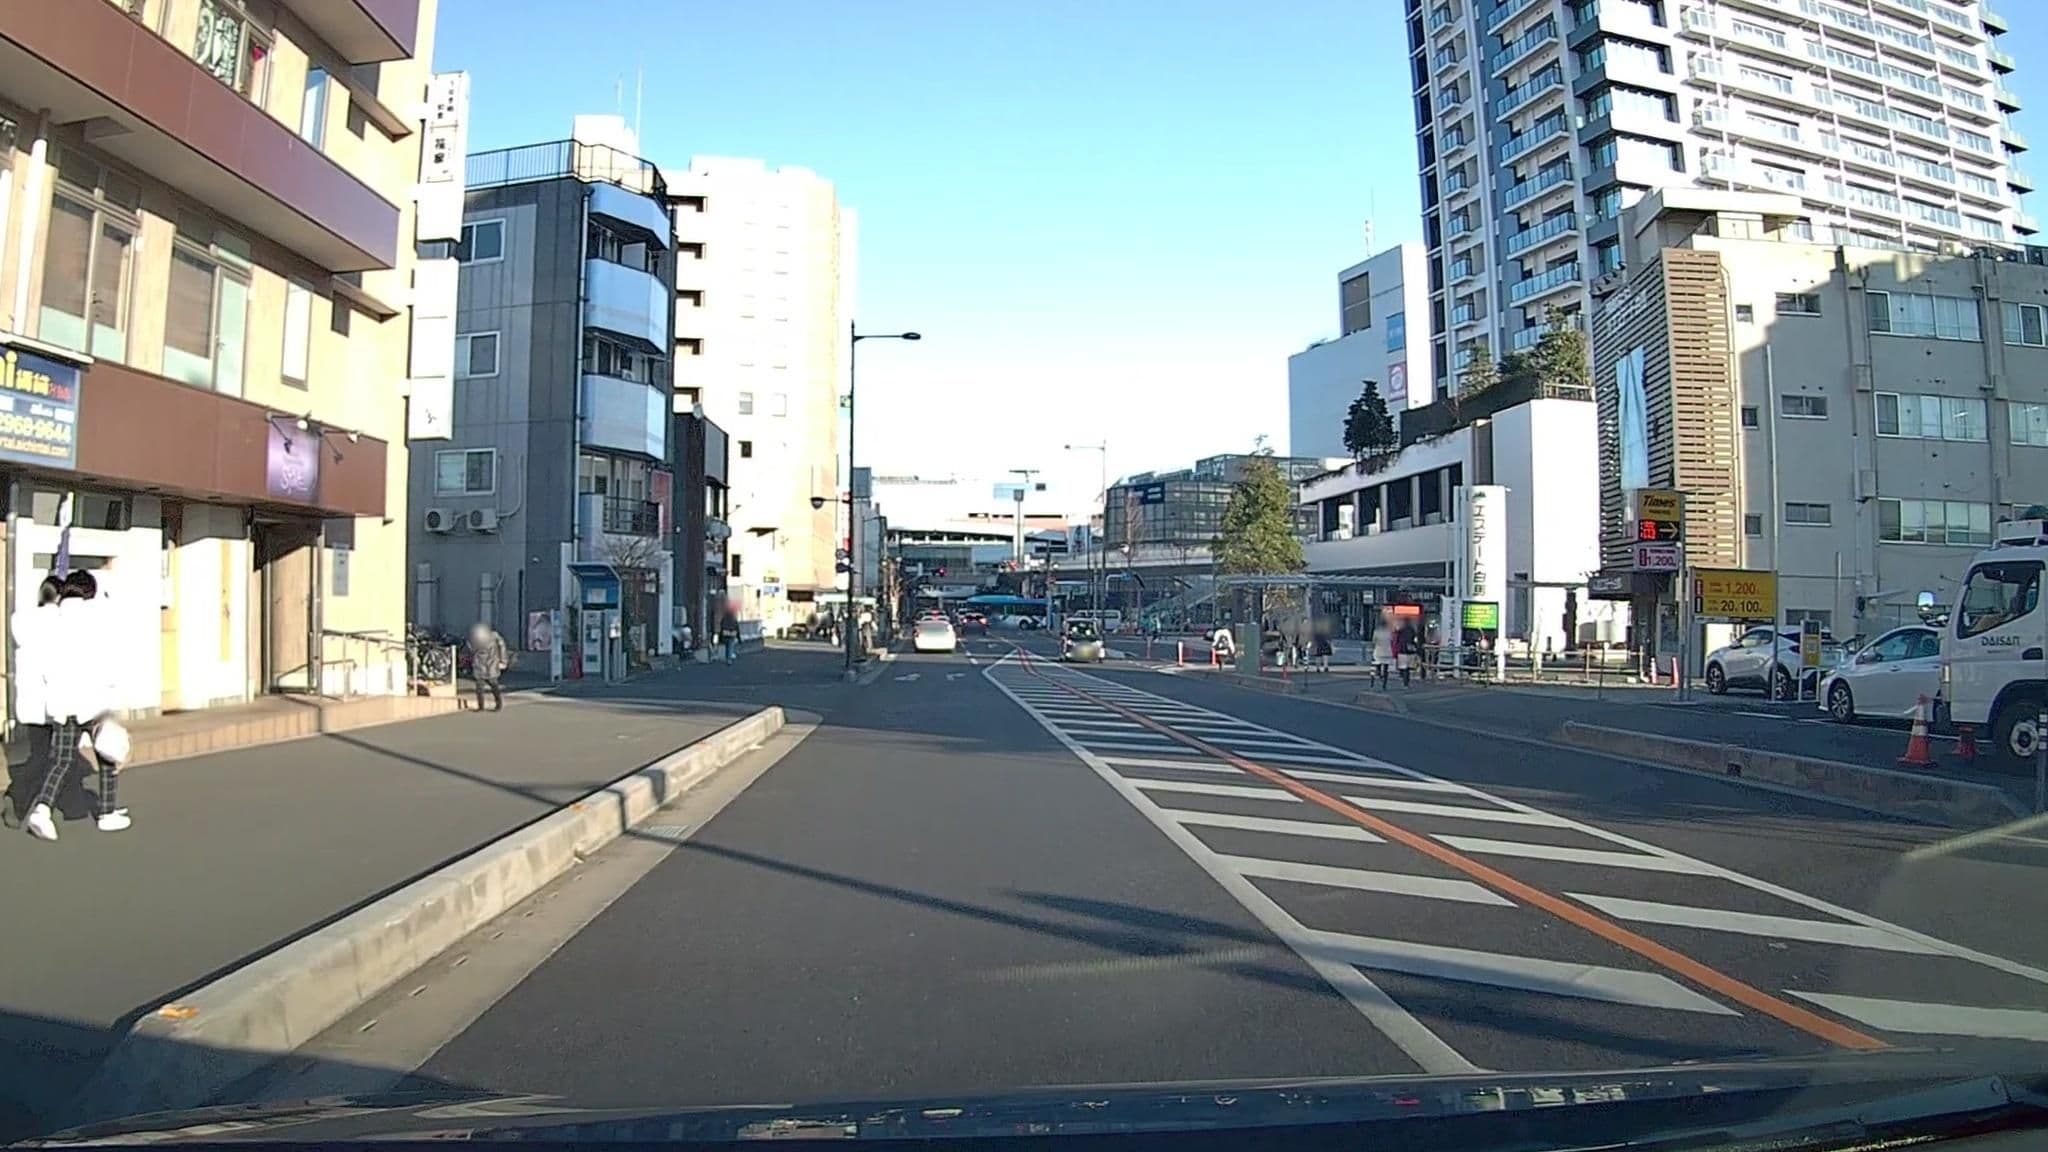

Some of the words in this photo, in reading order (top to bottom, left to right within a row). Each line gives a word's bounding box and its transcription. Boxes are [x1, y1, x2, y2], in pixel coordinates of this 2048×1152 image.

[1643, 495, 1677, 508] Times
[1472, 505, 1487, 596] エステート白馬
[1981, 635, 2020, 647] DAISAN
